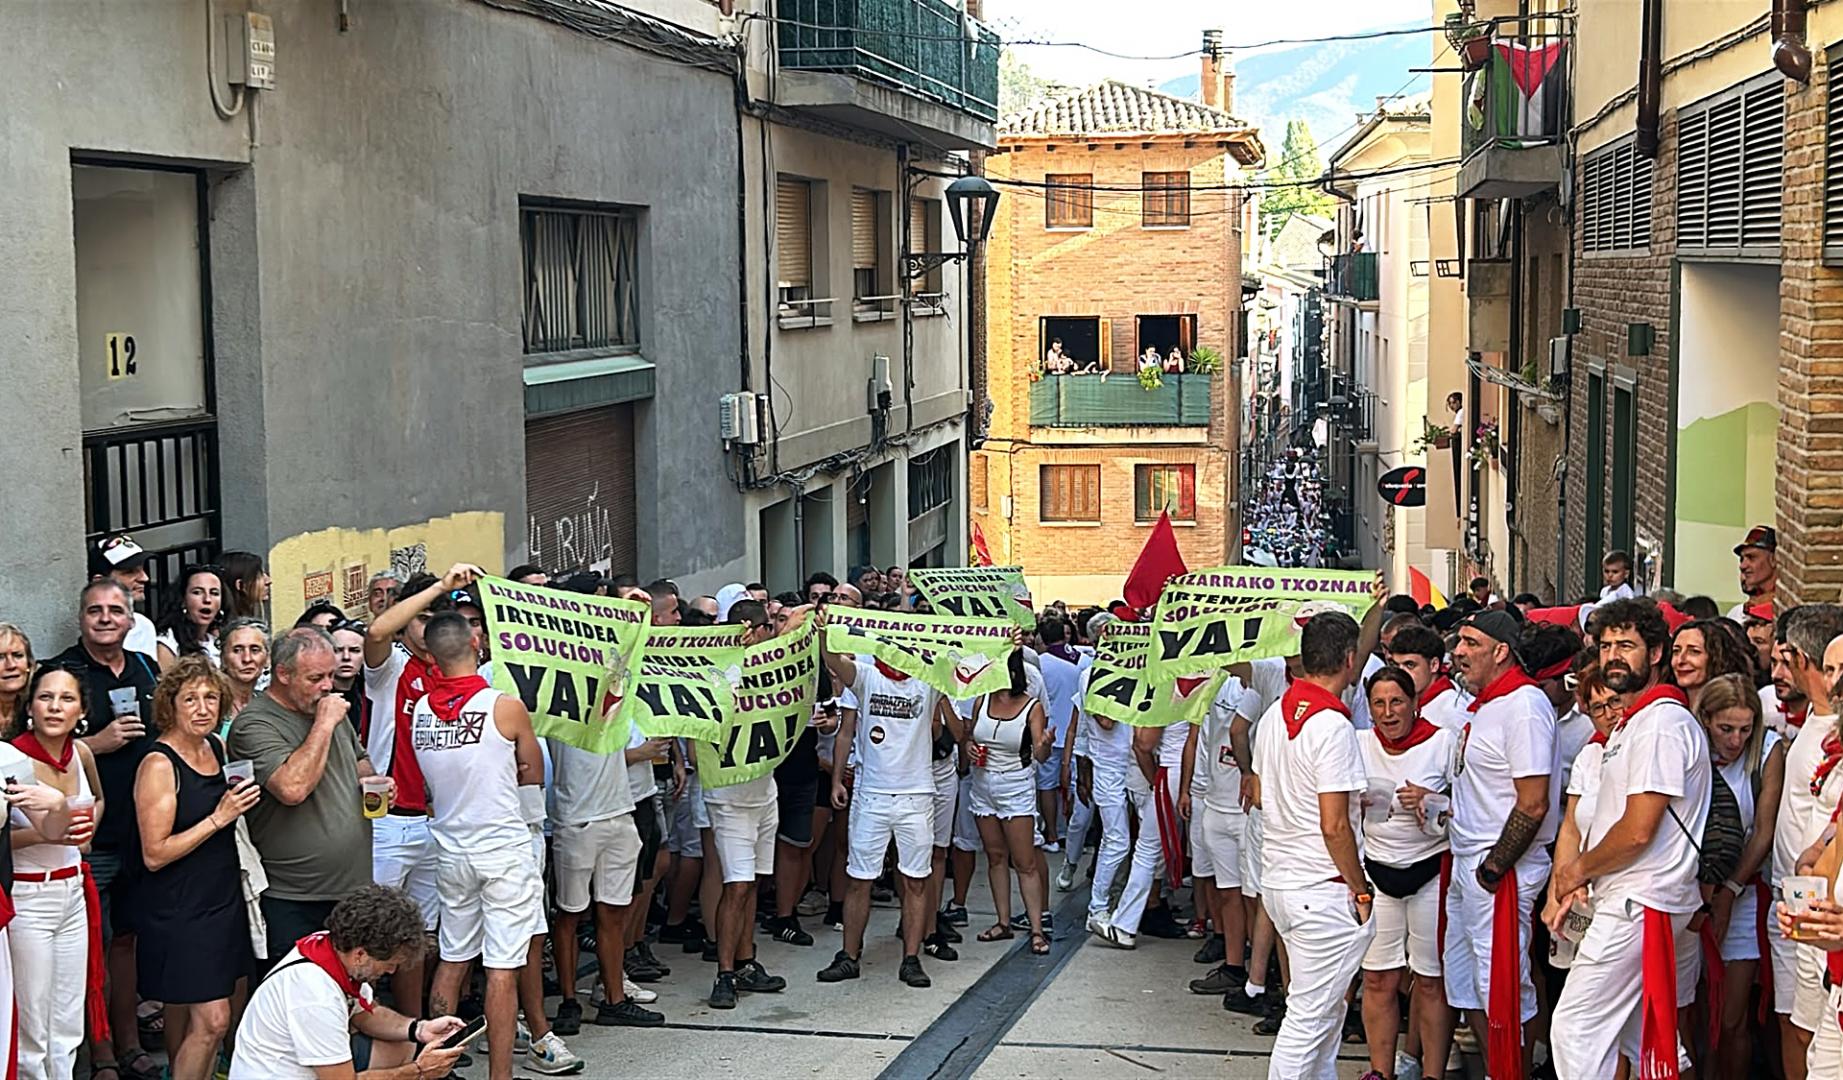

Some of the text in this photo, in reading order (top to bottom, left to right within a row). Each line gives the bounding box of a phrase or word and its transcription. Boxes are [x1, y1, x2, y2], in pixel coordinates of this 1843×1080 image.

[110, 336, 136, 376] 12
[488, 583, 581, 614] LIZARRAKO
[921, 575, 1006, 588] IRTENBIDEA
[1169, 574, 1373, 594] LIZARRAKO TXOZNAK
[937, 596, 1008, 618] YA!
[495, 604, 620, 645] IRTENBIDEA
[826, 614, 1012, 638] LIZARRAKO TXOZNAK
[1158, 617, 1264, 661] YA!
[499, 632, 605, 666] SOLUCIÓN
[736, 655, 815, 690] NBIDEA
[504, 661, 599, 726] YA!
[635, 682, 723, 724] YA!
[734, 684, 805, 714] UCIÓN
[710, 713, 799, 769] YA!
